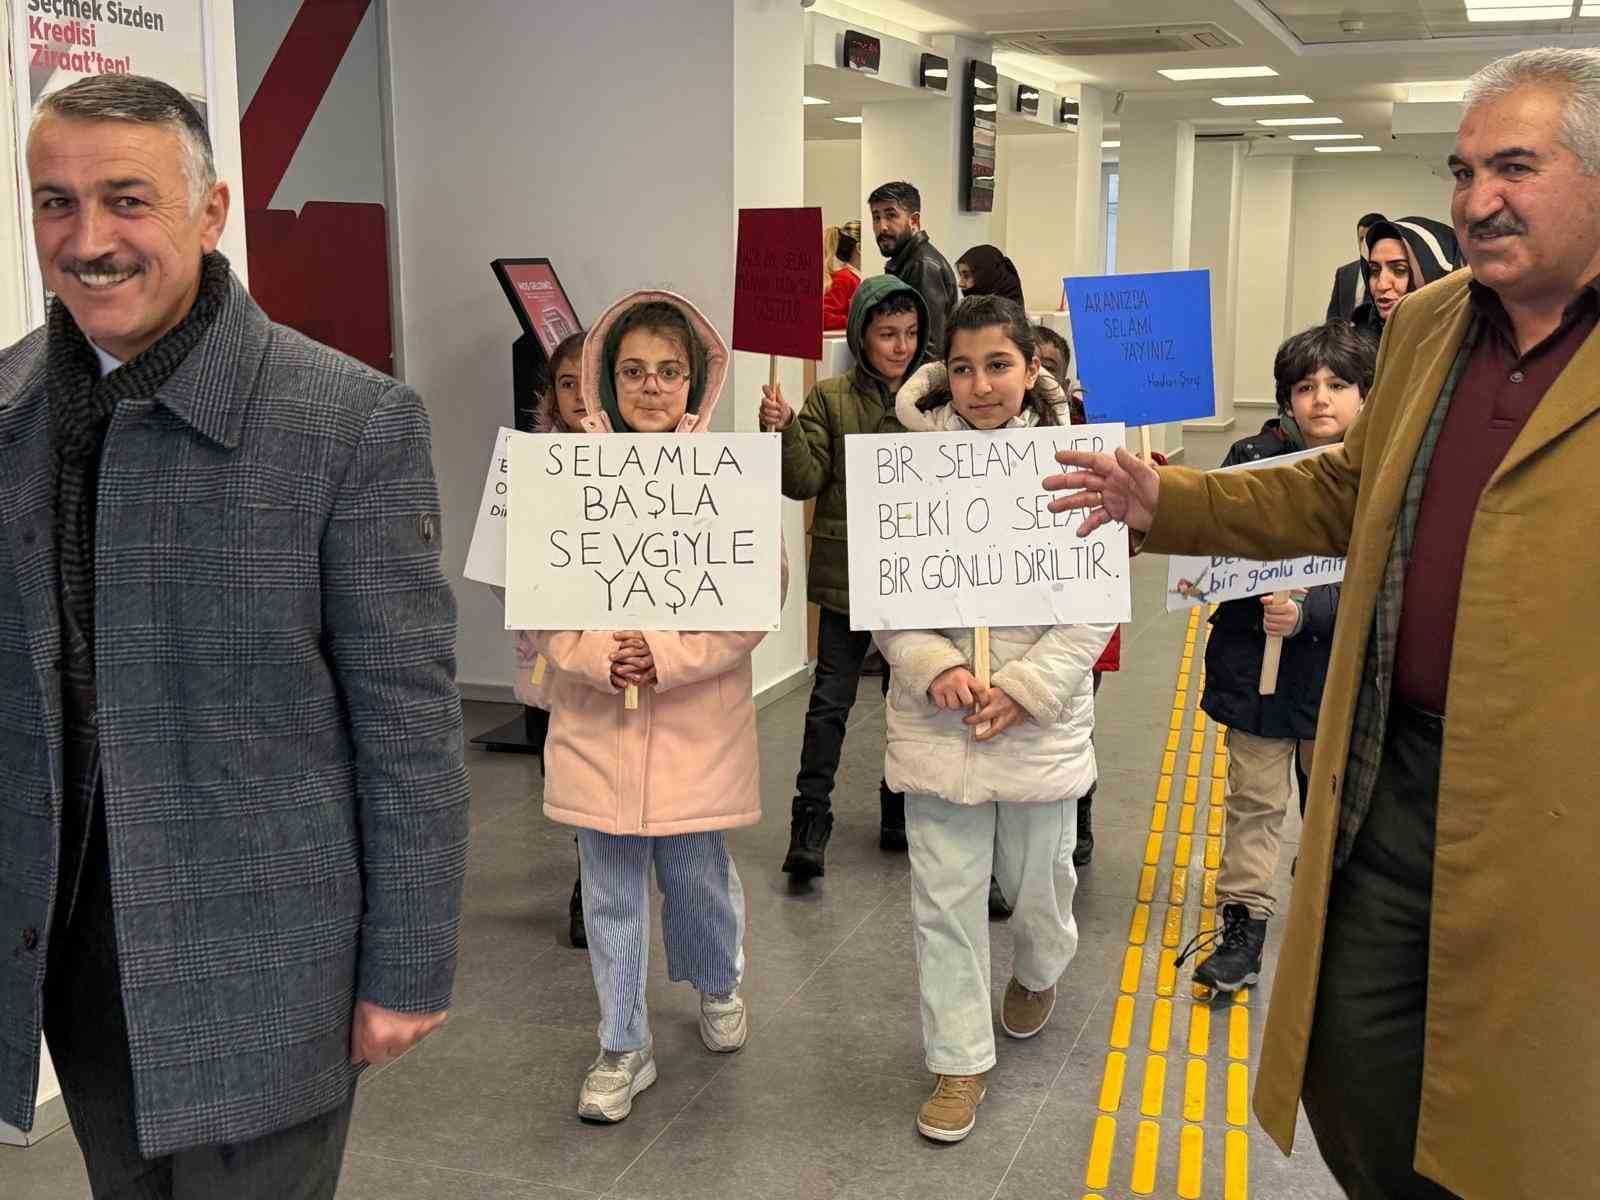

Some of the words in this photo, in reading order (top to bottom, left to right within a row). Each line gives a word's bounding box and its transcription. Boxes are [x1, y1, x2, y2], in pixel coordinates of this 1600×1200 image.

[28, 0, 103, 21] Seçmek
[107, 1, 164, 31] Sizden
[29, 16, 96, 47] Kredisi
[30, 44, 130, 74] Ziraat'ten!
[1121, 339, 1175, 363] YAYINIZ
[545, 443, 743, 477] SELAMLA
[876, 442, 923, 484] BİR
[936, 440, 1039, 479] SELAM
[583, 480, 719, 521] BAŞLA
[878, 491, 950, 540] BELKİ
[966, 497, 989, 533] O
[550, 530, 754, 567] SEVGİYLE
[879, 551, 912, 596] BİR
[921, 544, 1003, 590] GÖNLÜ
[1015, 539, 1120, 585] DİRİLTİR.
[1209, 570, 1239, 593] bir
[1246, 560, 1293, 592] gönlü
[594, 569, 723, 614] YAŞA
